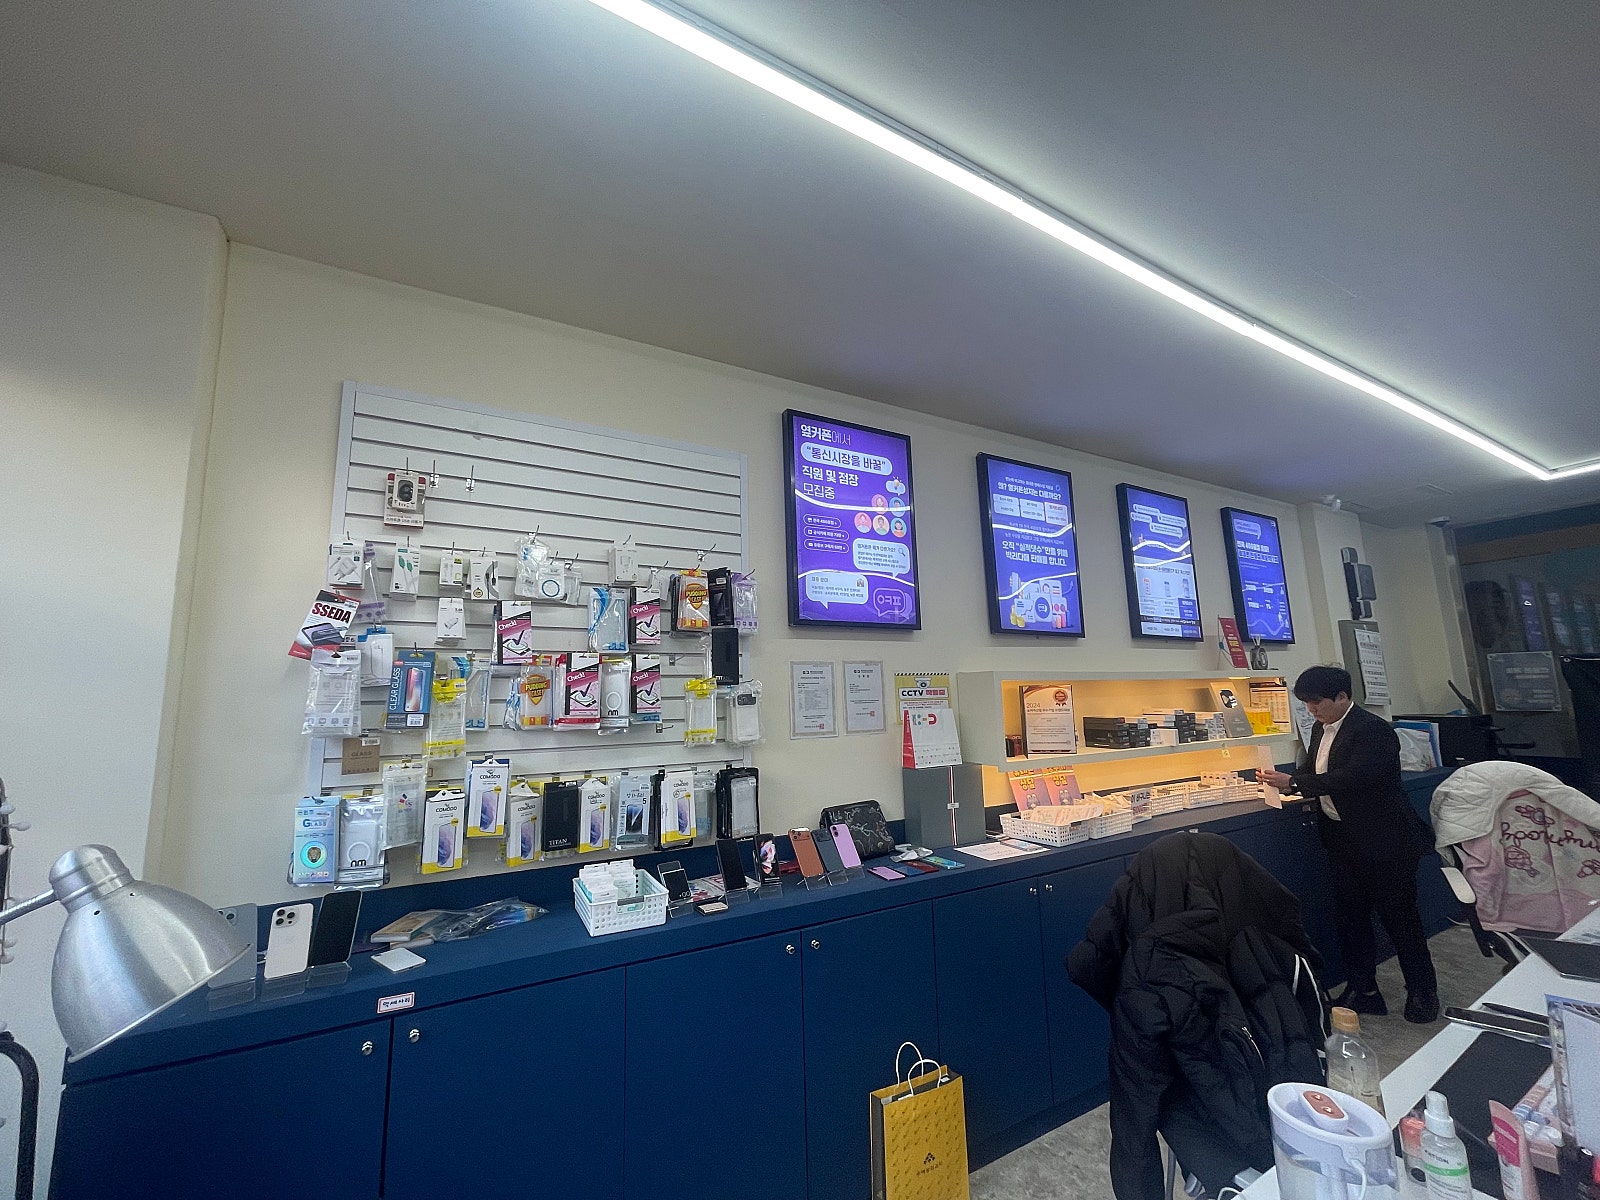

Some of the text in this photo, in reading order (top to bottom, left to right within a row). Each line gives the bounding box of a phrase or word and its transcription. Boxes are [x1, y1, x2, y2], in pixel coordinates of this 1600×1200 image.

[801, 424, 851, 445] 옆커폰에서
[802, 465, 859, 487] 직원 및 점장
[803, 482, 836, 500] 모집중
[1002, 540, 1015, 550] 오직
[311, 602, 353, 624] SSEDA
[632, 605, 649, 614] Check!
[498, 619, 518, 631] Check!
[567, 672, 585, 682] Check!
[632, 673, 649, 682] Check!
[389, 667, 401, 711] CLEAR GLASS
[901, 689, 924, 697] CCTV
[1020, 778, 1035, 790] 상담
[1052, 774, 1067, 786] 상담
[549, 838, 568, 846] TITAN
